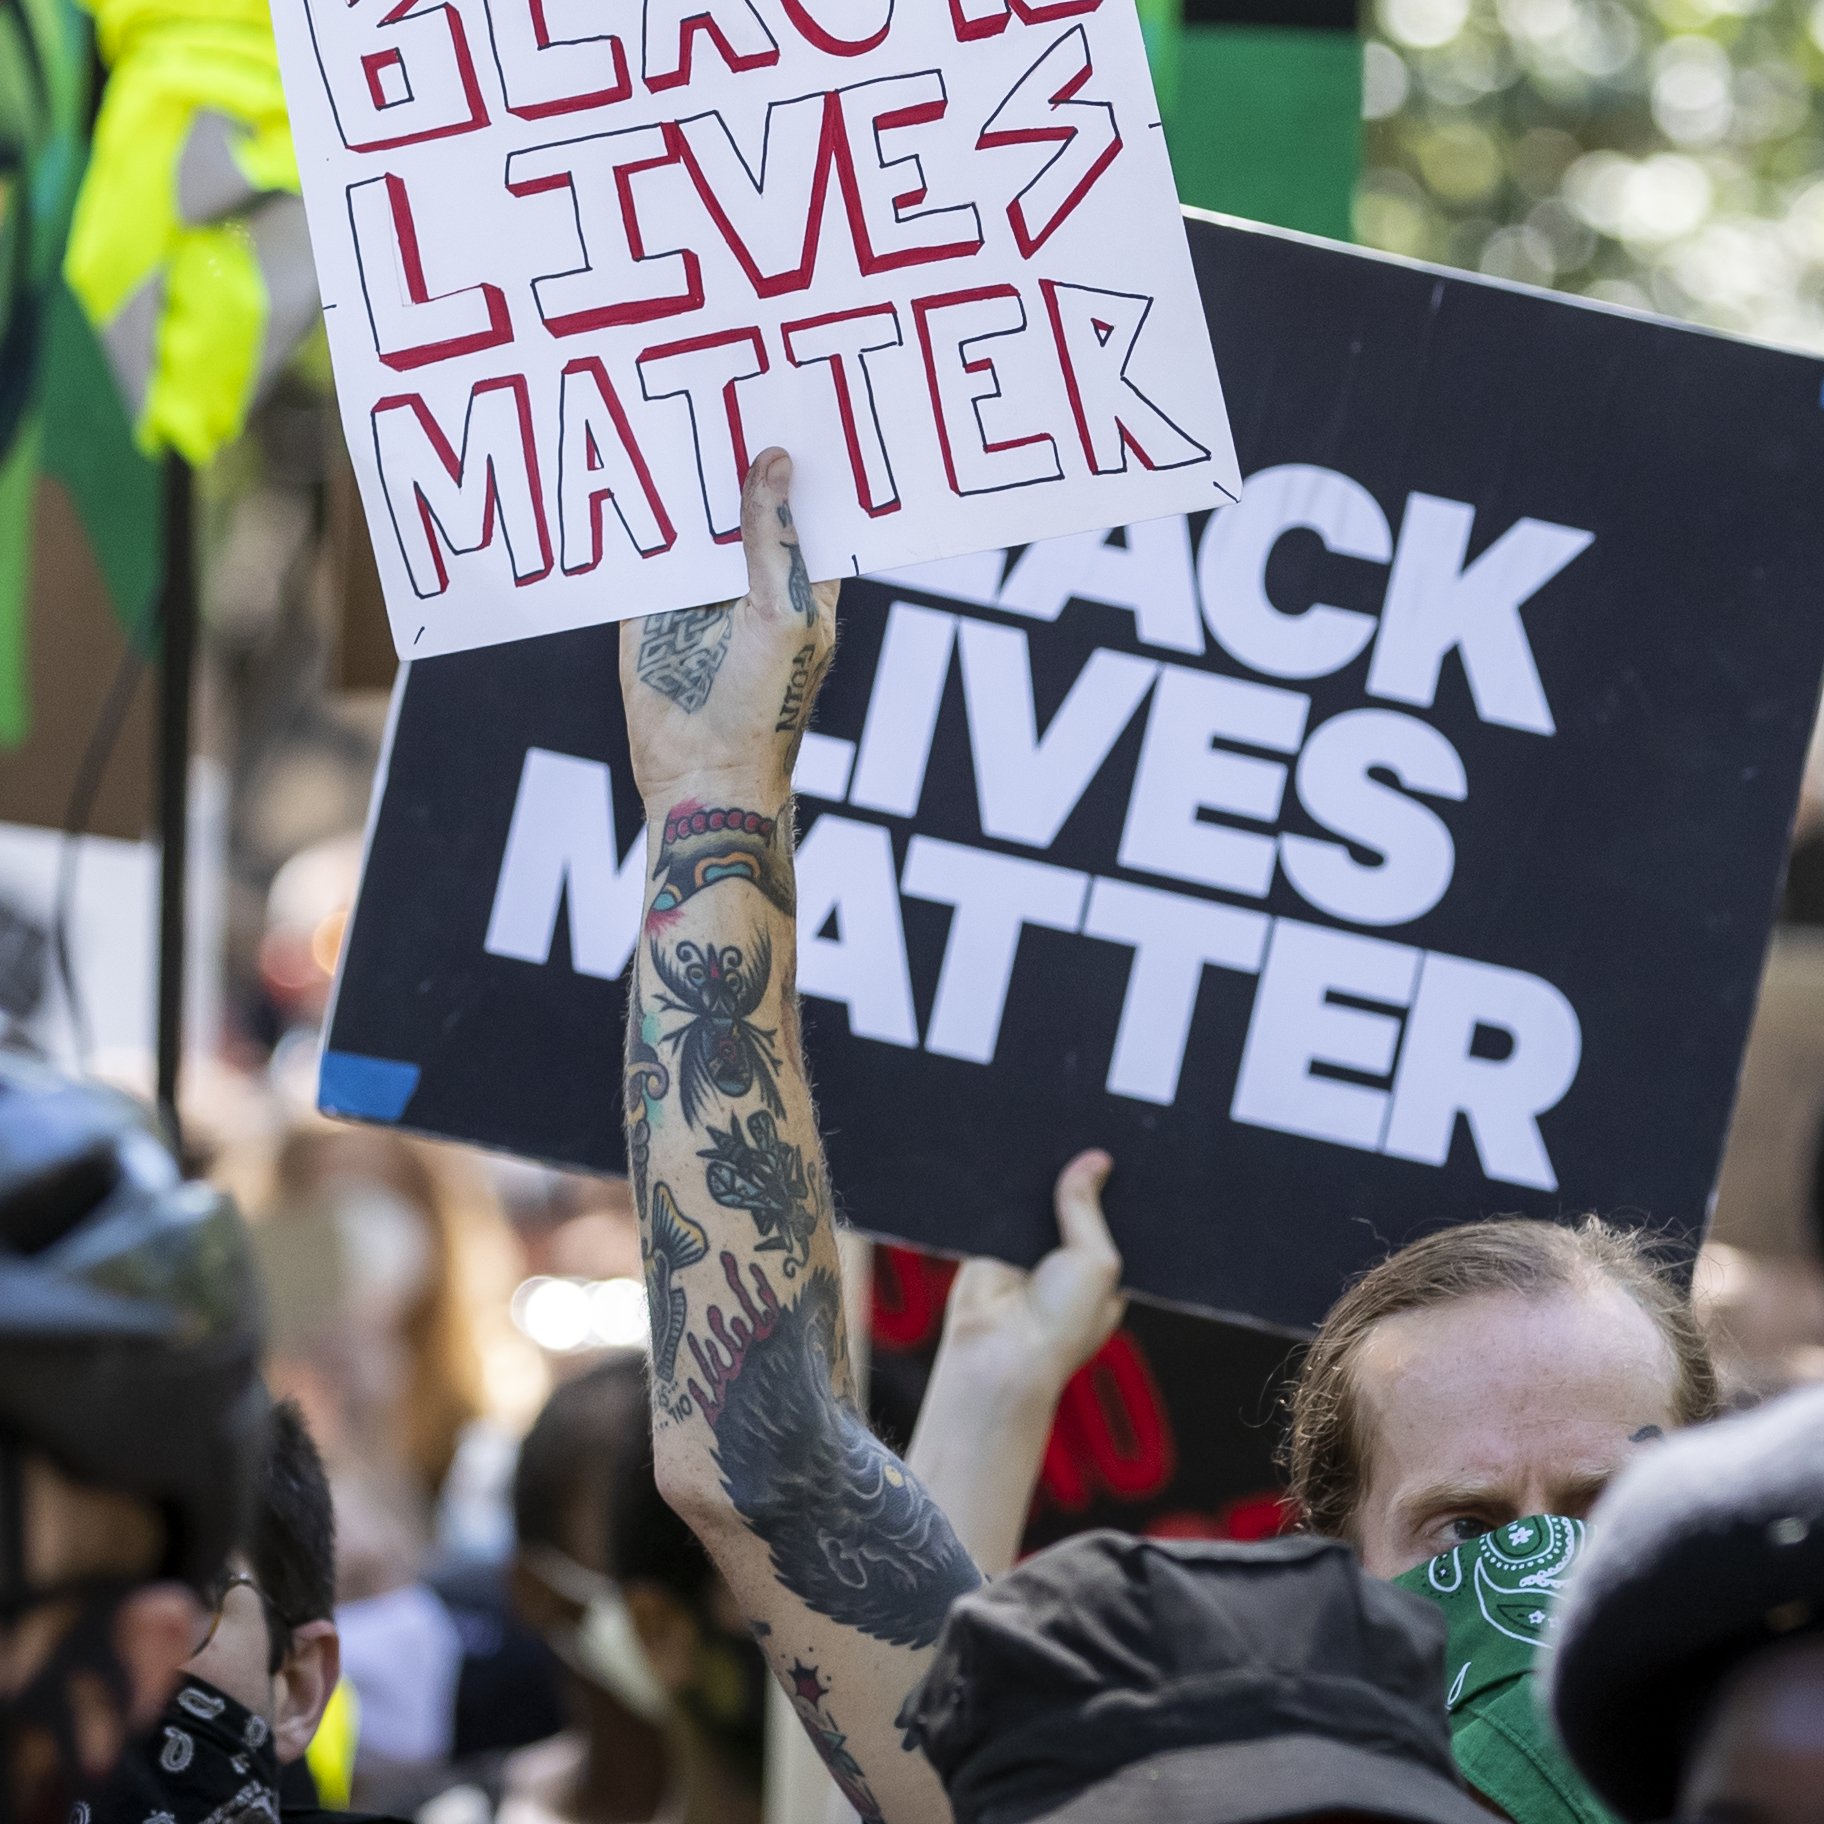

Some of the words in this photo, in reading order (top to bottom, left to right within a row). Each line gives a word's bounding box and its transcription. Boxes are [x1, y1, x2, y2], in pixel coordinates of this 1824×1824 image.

[346, 23, 1123, 372] LIVES
[370, 280, 1211, 598] MATTER
[859, 463, 1596, 736] ACK
